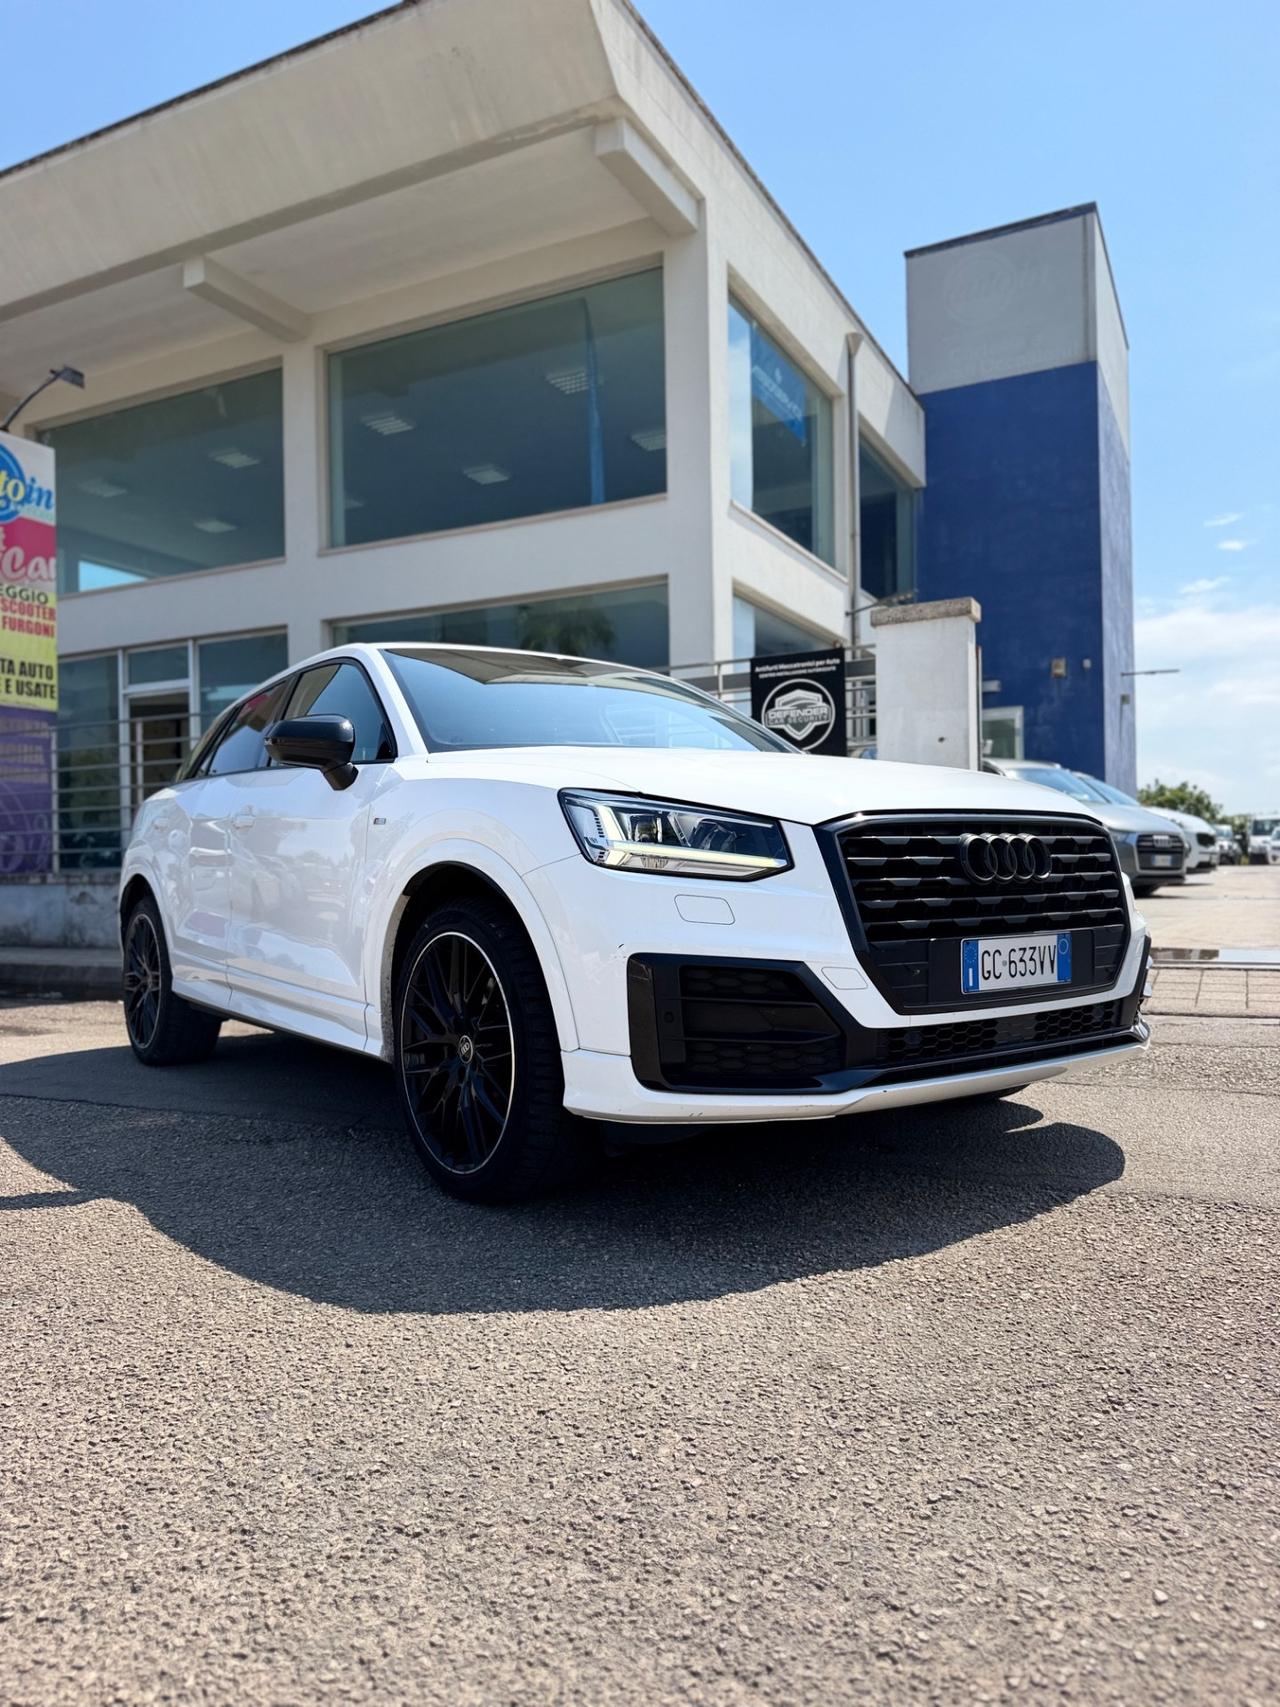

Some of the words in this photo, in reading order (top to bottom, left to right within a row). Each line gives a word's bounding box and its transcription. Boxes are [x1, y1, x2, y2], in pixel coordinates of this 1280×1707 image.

[1, 597, 56, 621] SCOOTER
[2, 615, 54, 638] FURGONI
[19, 661, 54, 681] AUTO
[5, 678, 12, 694] E
[15, 679, 56, 700] USATE
[768, 707, 828, 720] DEFENDER
[788, 714, 828, 724] SECURITY
